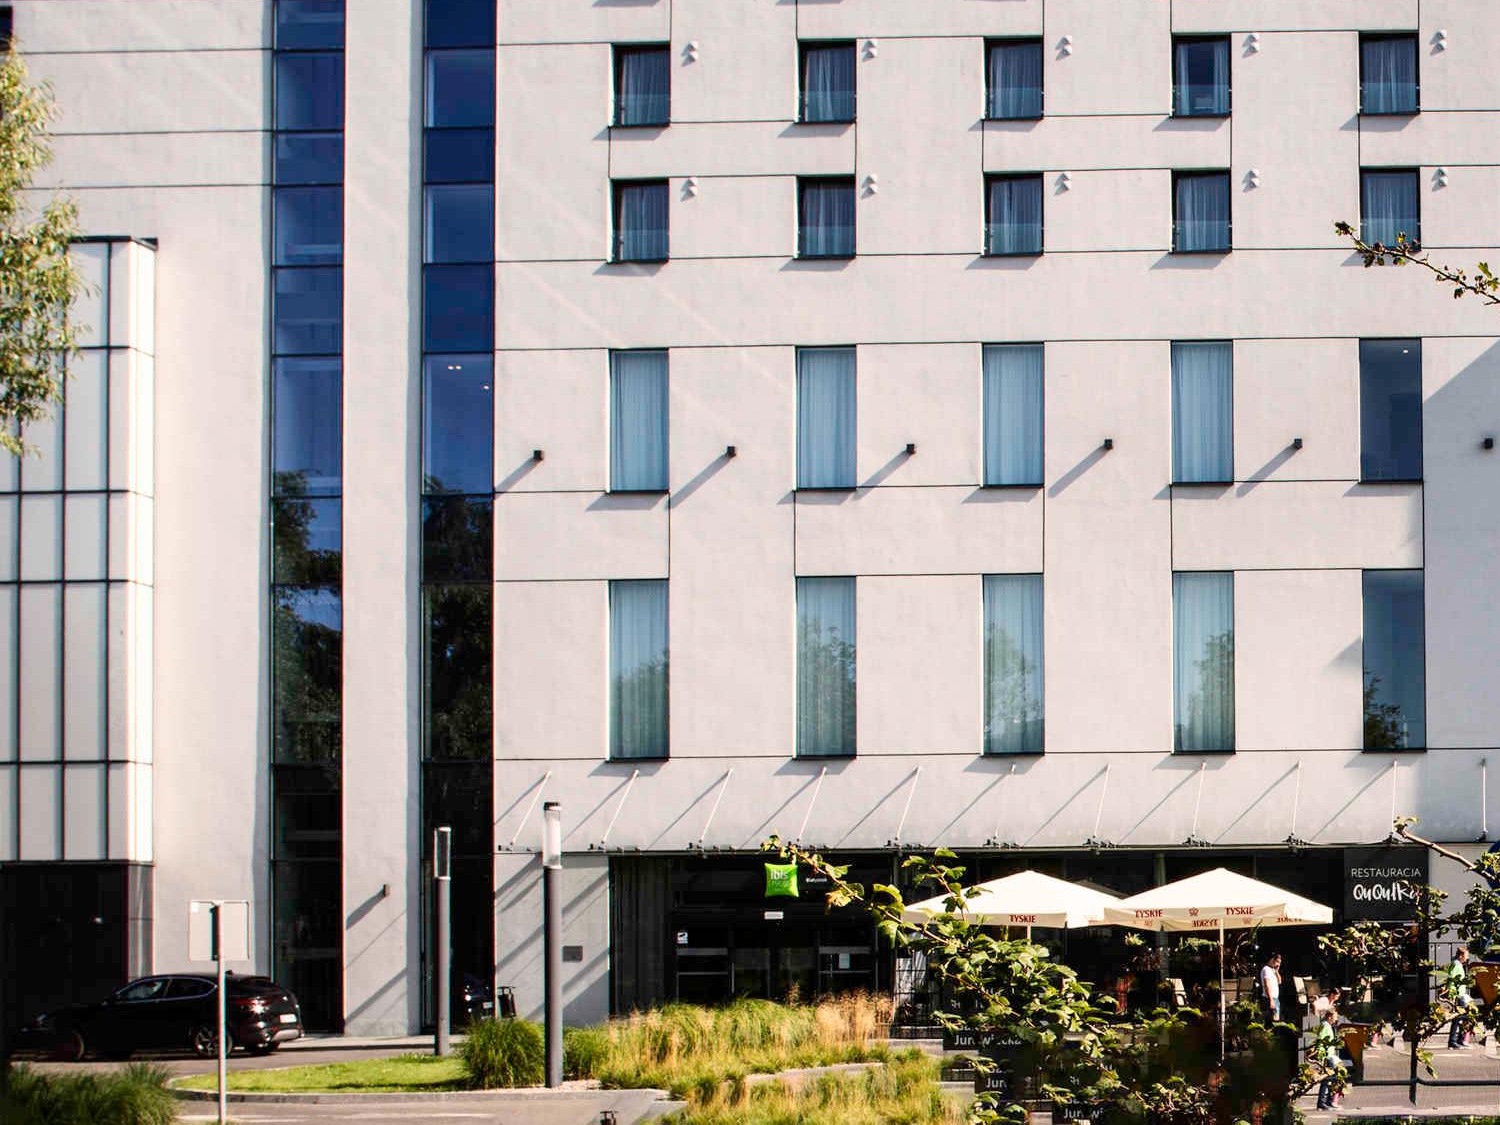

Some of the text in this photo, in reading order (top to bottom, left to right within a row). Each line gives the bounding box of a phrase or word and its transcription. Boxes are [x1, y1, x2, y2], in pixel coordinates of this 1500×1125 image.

[1135, 909, 1163, 918] TYSKIE
[1225, 907, 1254, 915] TYSKIE
[1009, 914, 1037, 923] TYSKIE
